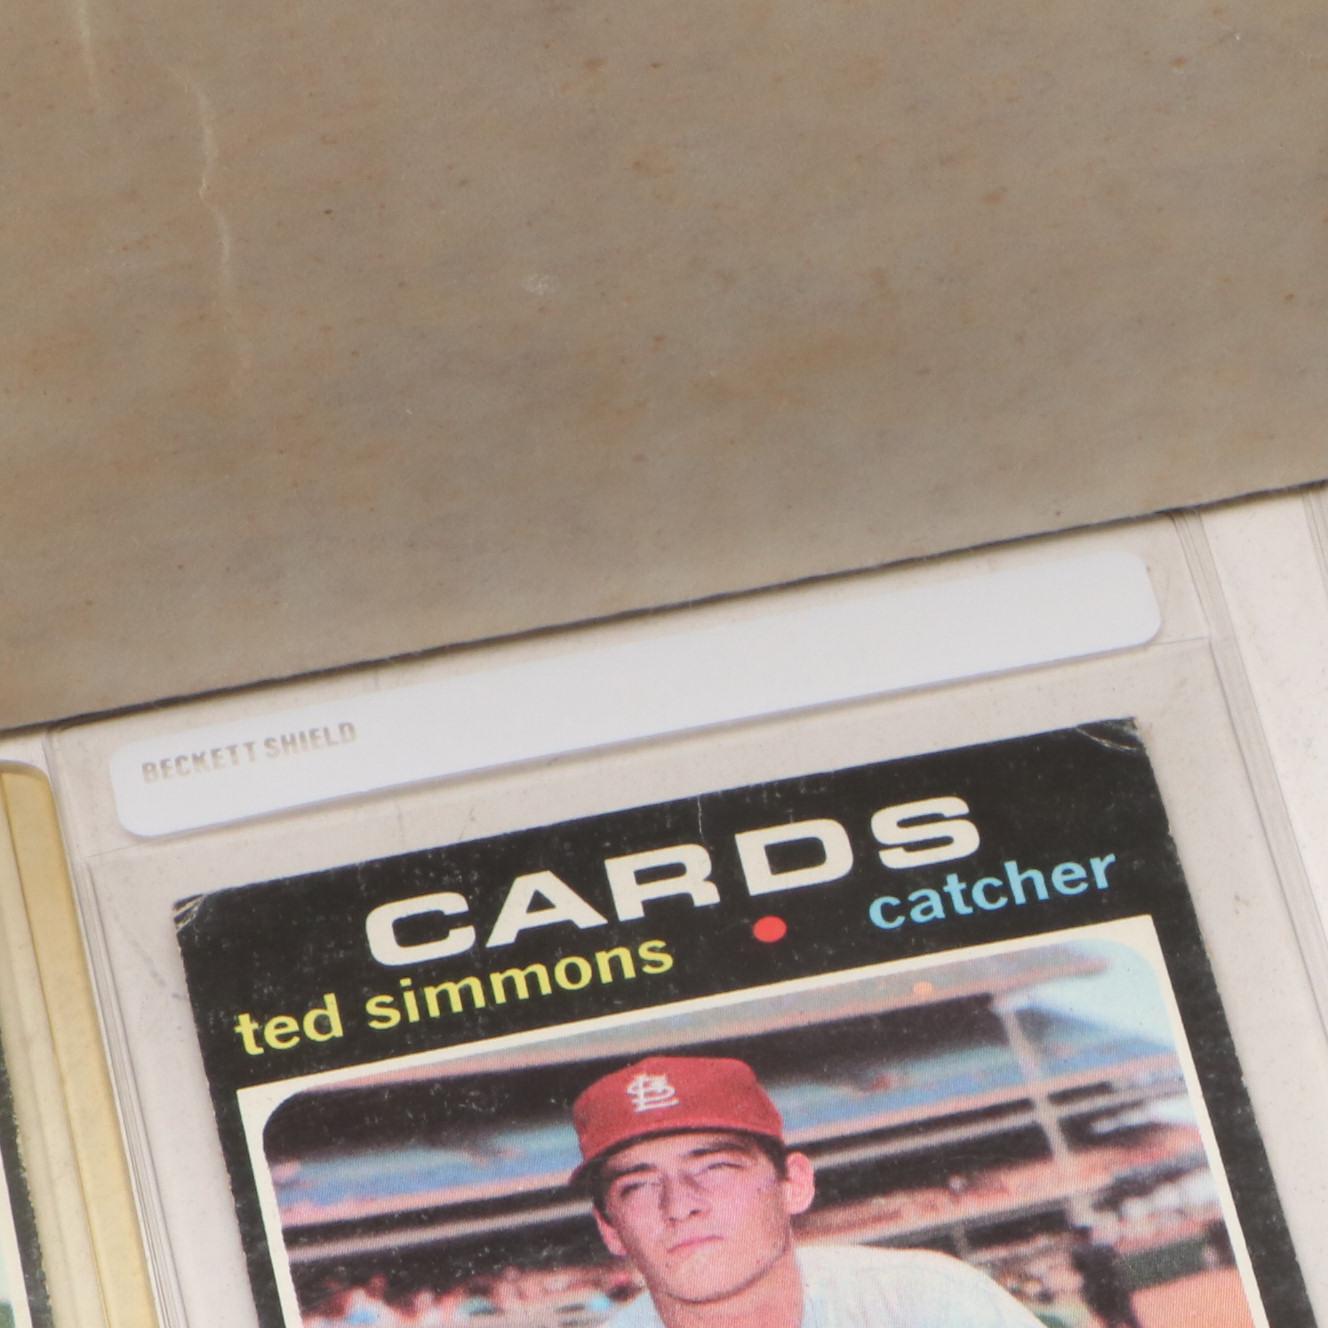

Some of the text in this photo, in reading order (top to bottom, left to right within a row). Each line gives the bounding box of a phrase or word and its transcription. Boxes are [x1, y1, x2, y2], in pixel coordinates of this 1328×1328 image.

[141, 721, 358, 784] BECKETT SHIELD
[365, 796, 980, 967] CARDS
[868, 852, 1116, 930] catcher
[235, 938, 673, 1056] ted simmons
